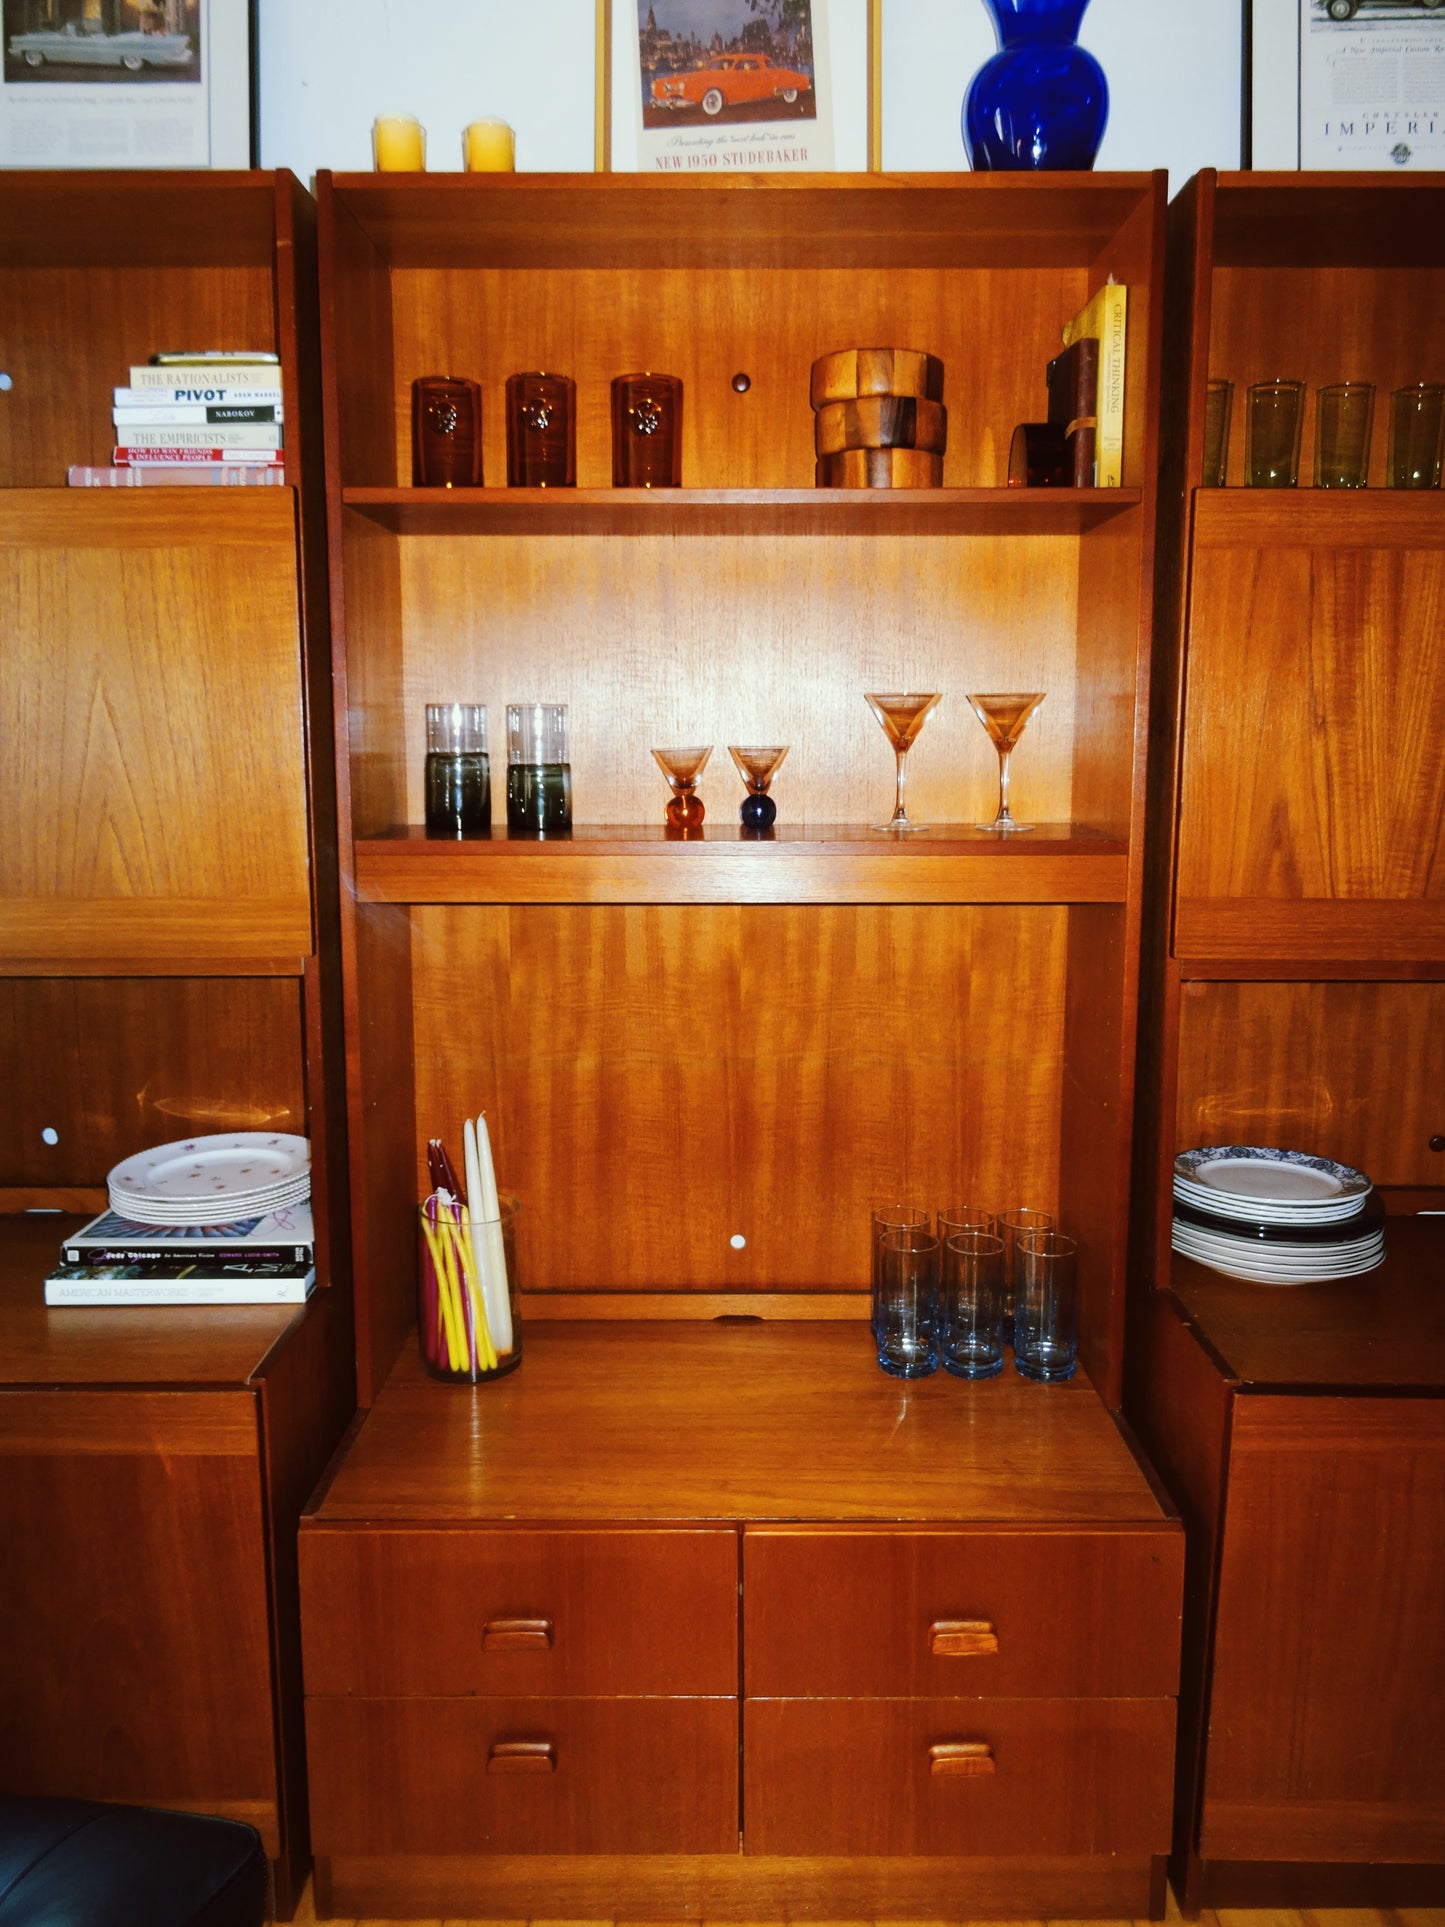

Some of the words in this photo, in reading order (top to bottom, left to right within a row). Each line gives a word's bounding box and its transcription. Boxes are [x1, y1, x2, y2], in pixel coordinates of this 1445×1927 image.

[1369, 45, 1402, 56] Imperial
[1362, 111, 1439, 119] CHRYSLER
[1324, 120, 1445, 136] IMPERI
[666, 135, 714, 149] Presenting
[715, 134, 728, 145] the
[779, 133, 796, 141] cars
[655, 156, 681, 170] NEW
[687, 153, 718, 168] 1950
[722, 147, 809, 166] STUDEBAKER
[1110, 304, 1122, 355] CRITICAL
[140, 373, 164, 385] THE
[166, 372, 249, 385] RATIONALISTS
[1110, 358, 1121, 414] THINKING
[174, 389, 228, 401] PIVOT
[215, 410, 255, 418] NABOKOV
[133, 432, 156, 445] THE
[160, 432, 226, 445] EMPIRICISTS
[127, 1251, 161, 1259] Chicago
[58, 1287, 112, 1298] AMERICAN
[114, 1287, 189, 1298] MASTERWORKS
